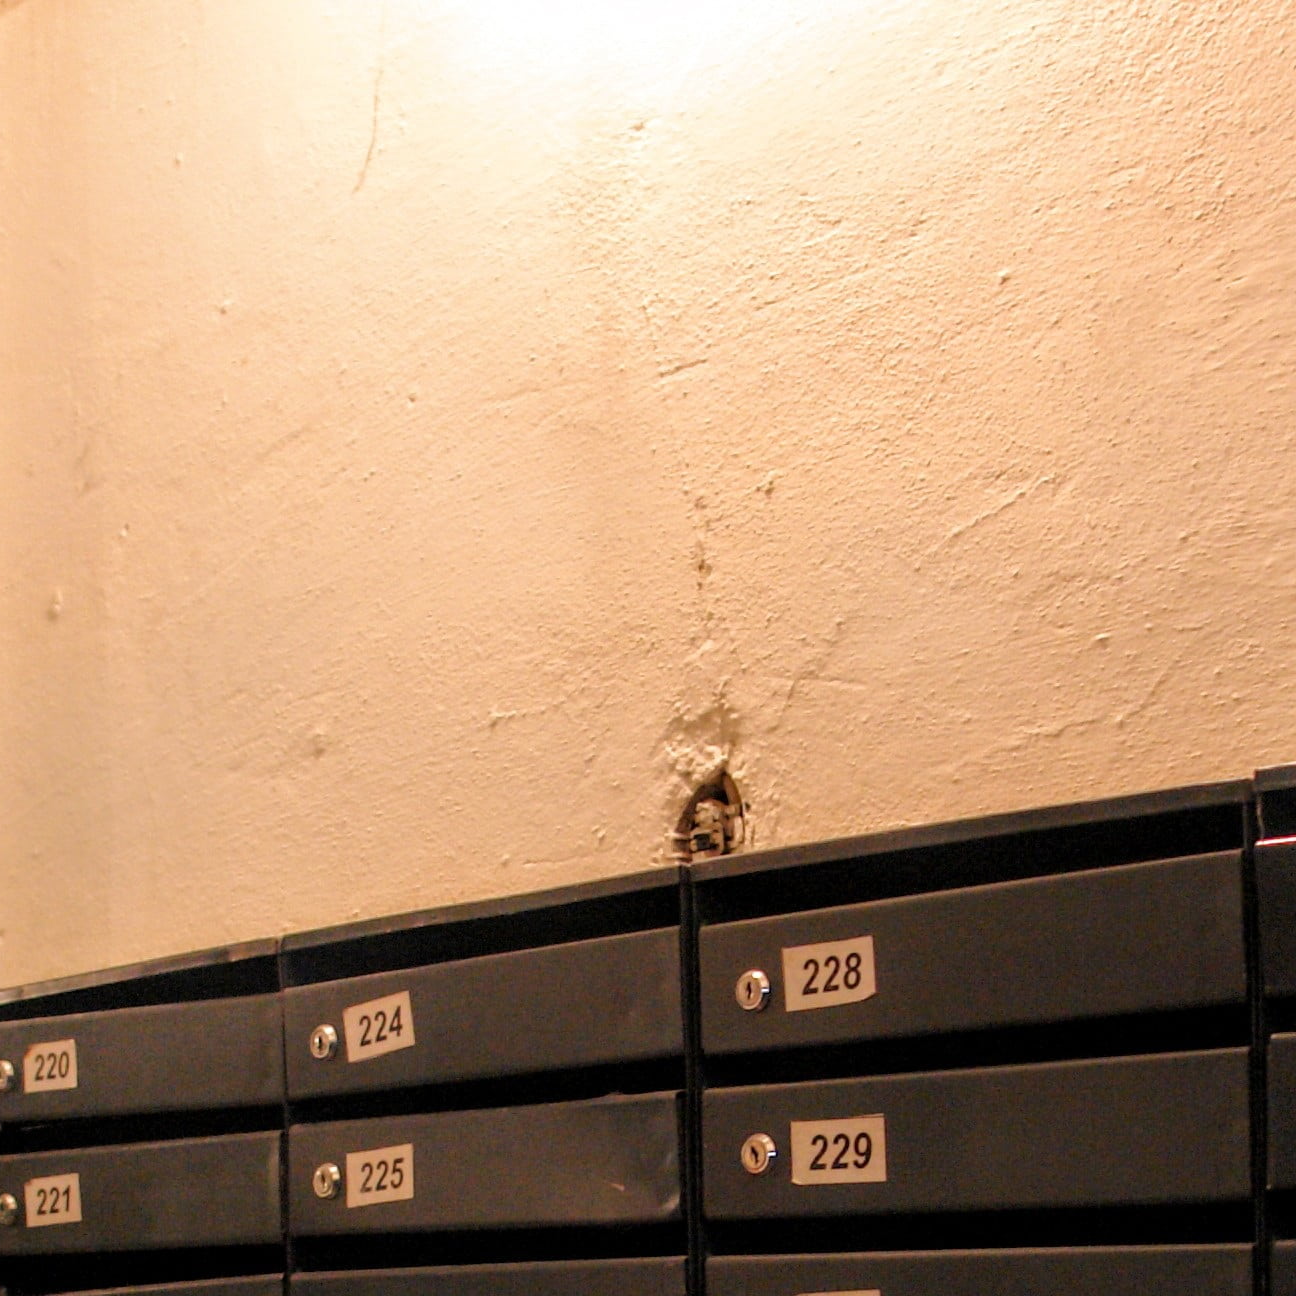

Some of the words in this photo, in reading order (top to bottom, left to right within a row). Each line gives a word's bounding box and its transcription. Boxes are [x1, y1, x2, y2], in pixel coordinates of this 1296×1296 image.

[802, 952, 862, 996] 228
[359, 1006, 403, 1047] 224
[33, 1051, 70, 1082] 220
[809, 1132, 872, 1170] 229
[360, 1158, 404, 1193] 225
[36, 1186, 72, 1216] 221
